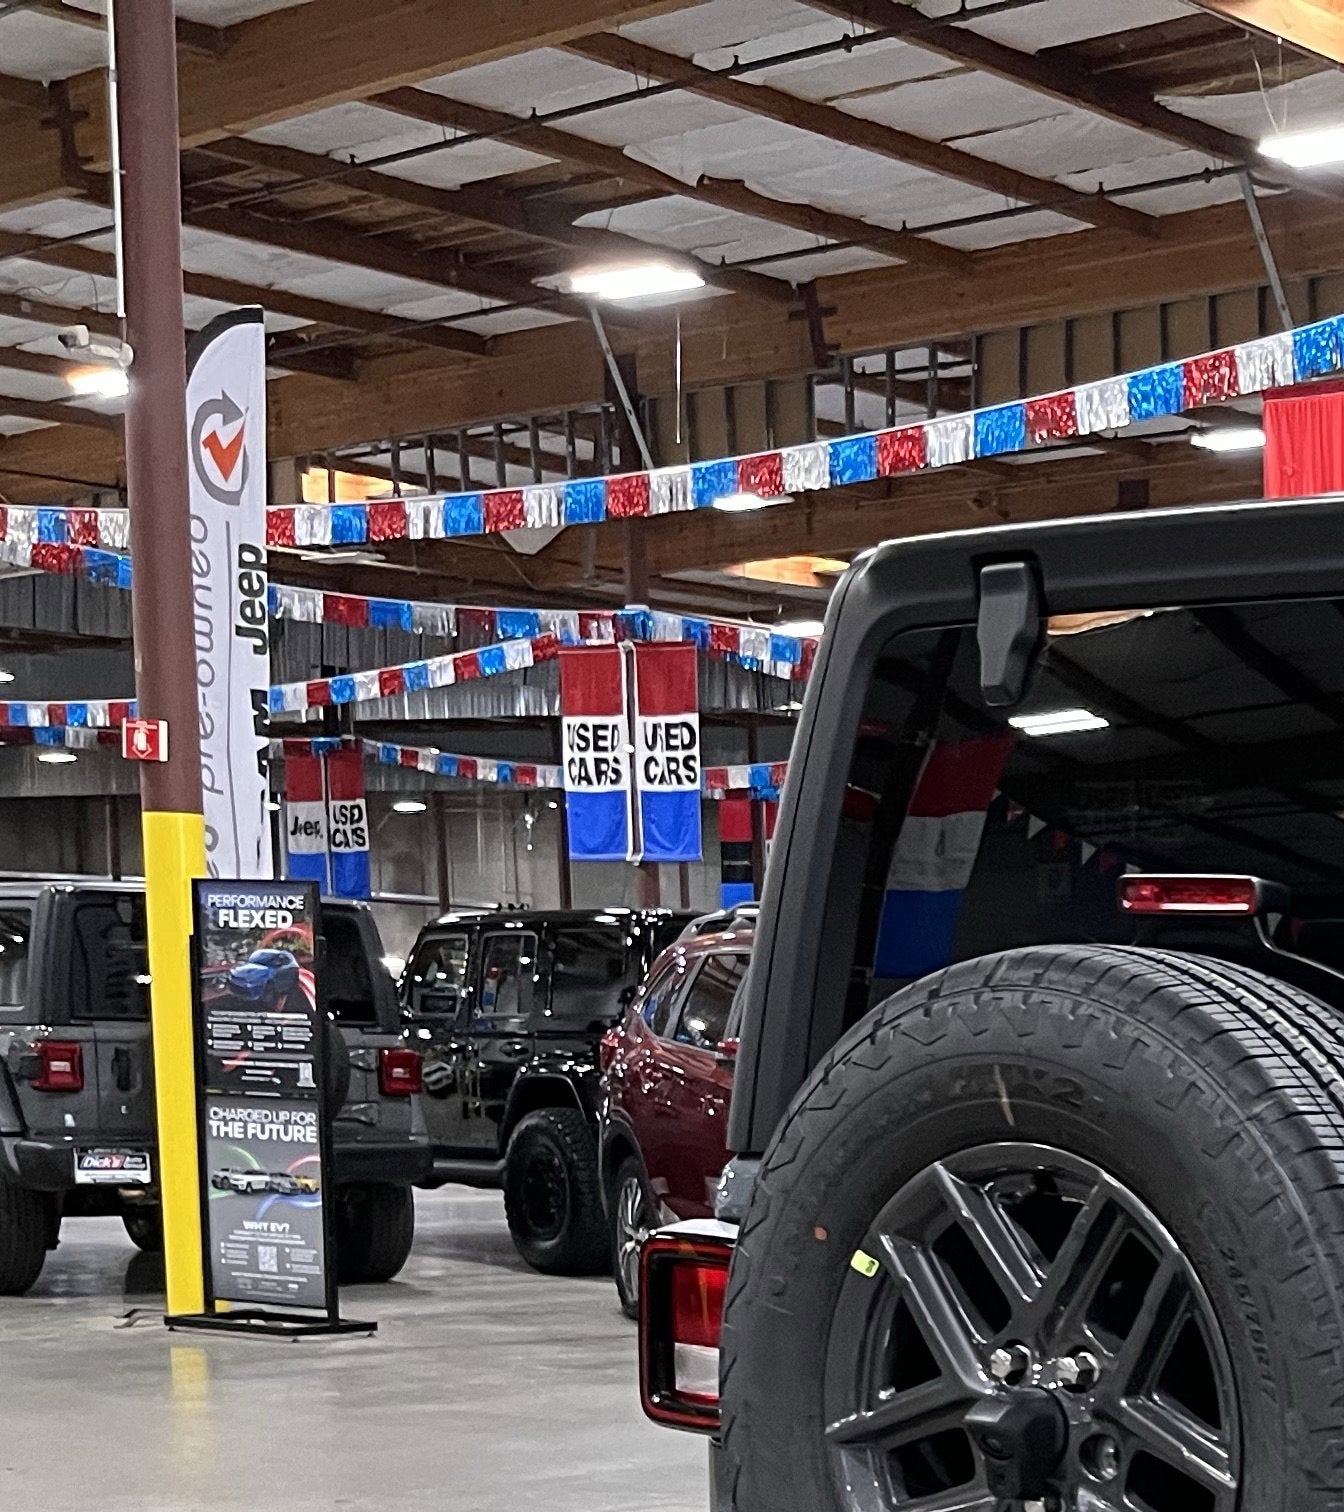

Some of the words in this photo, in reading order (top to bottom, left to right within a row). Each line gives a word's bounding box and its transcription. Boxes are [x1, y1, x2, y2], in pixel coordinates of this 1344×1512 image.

[235, 543, 268, 655] Jeep
[567, 722, 620, 752] USED
[568, 756, 623, 785] CARS
[207, 894, 304, 910] PERFORMANCE
[218, 909, 293, 929] FLEXED
[210, 1107, 272, 1123] CHARGED
[273, 1111, 290, 1124] UP
[291, 1112, 317, 1126] FOR
[209, 1120, 244, 1139] THE
[247, 1122, 318, 1143] FUTURE
